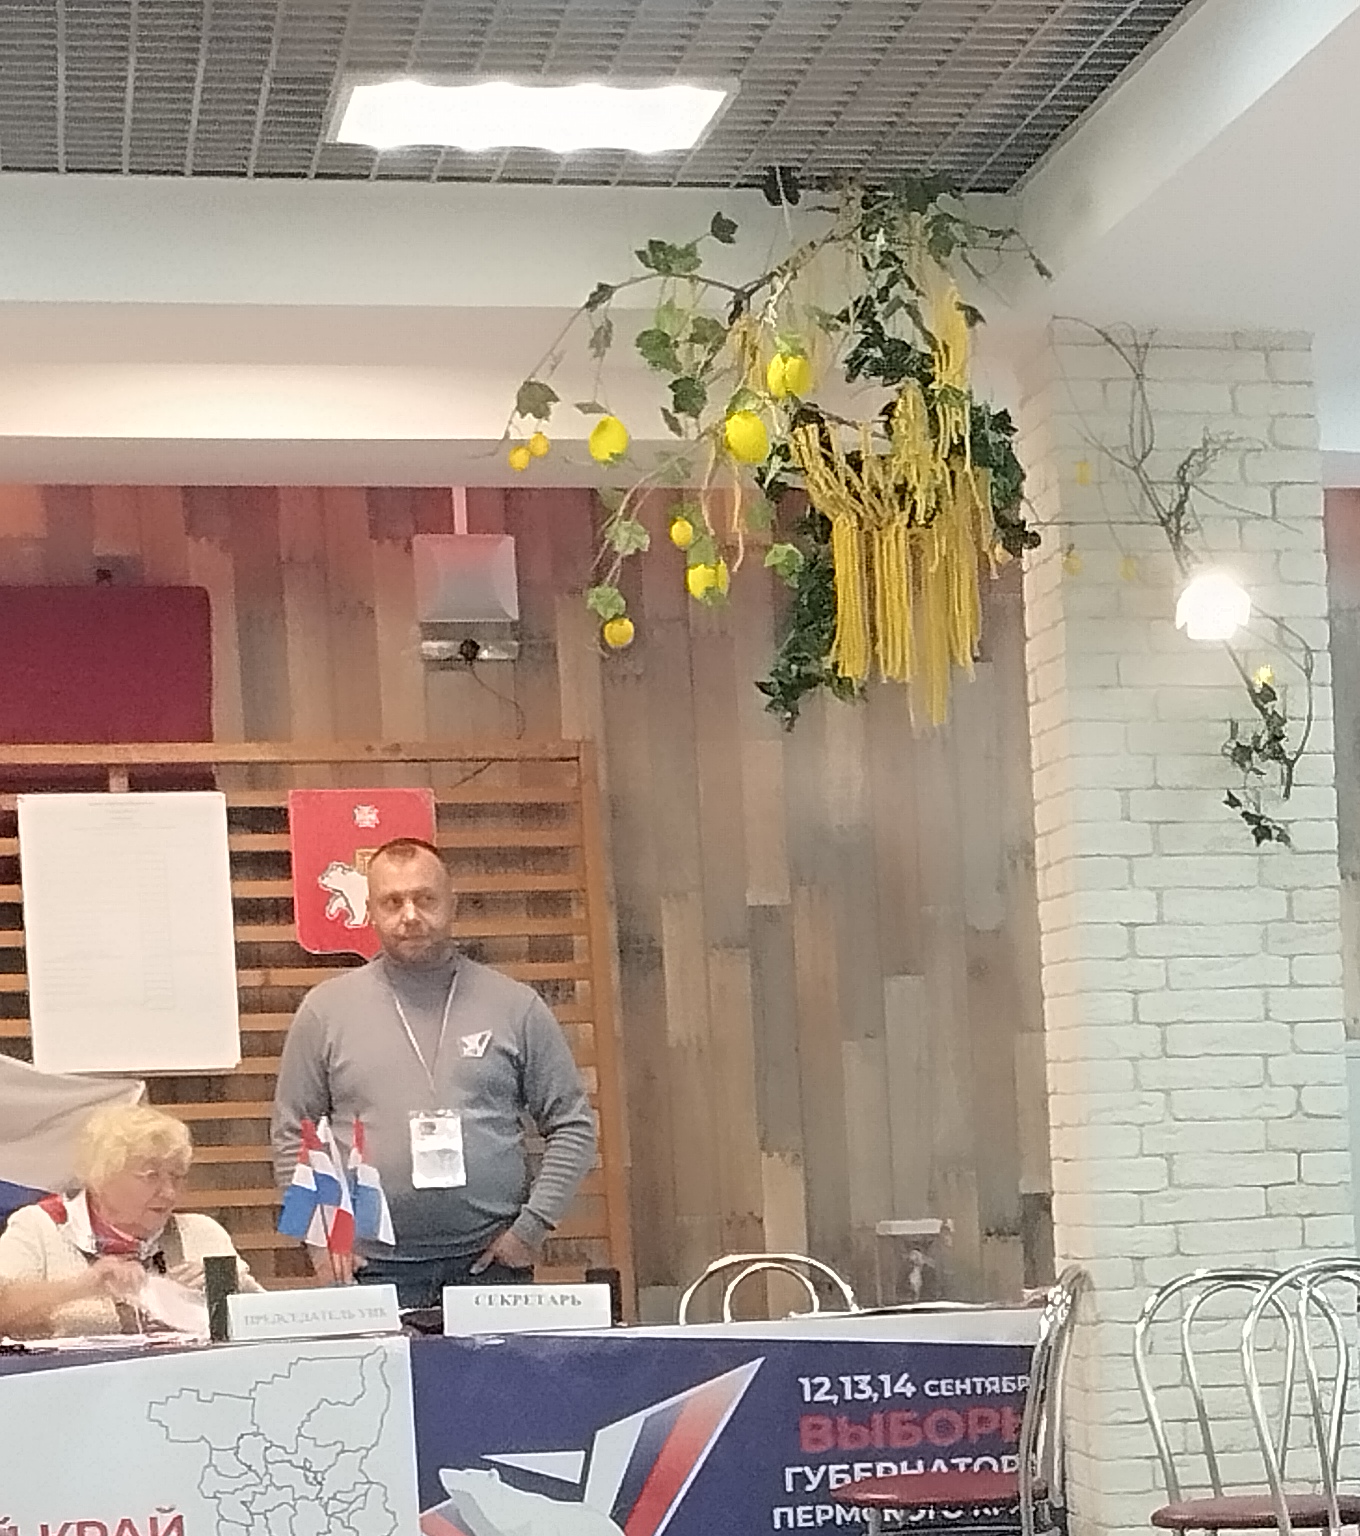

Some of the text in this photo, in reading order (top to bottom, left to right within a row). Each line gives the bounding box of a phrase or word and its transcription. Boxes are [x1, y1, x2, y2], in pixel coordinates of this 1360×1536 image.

[474, 1293, 583, 1307] СЕКРЕТАРЬ
[798, 1372, 1031, 1406] 12,13,14 СЕНТЯБР
